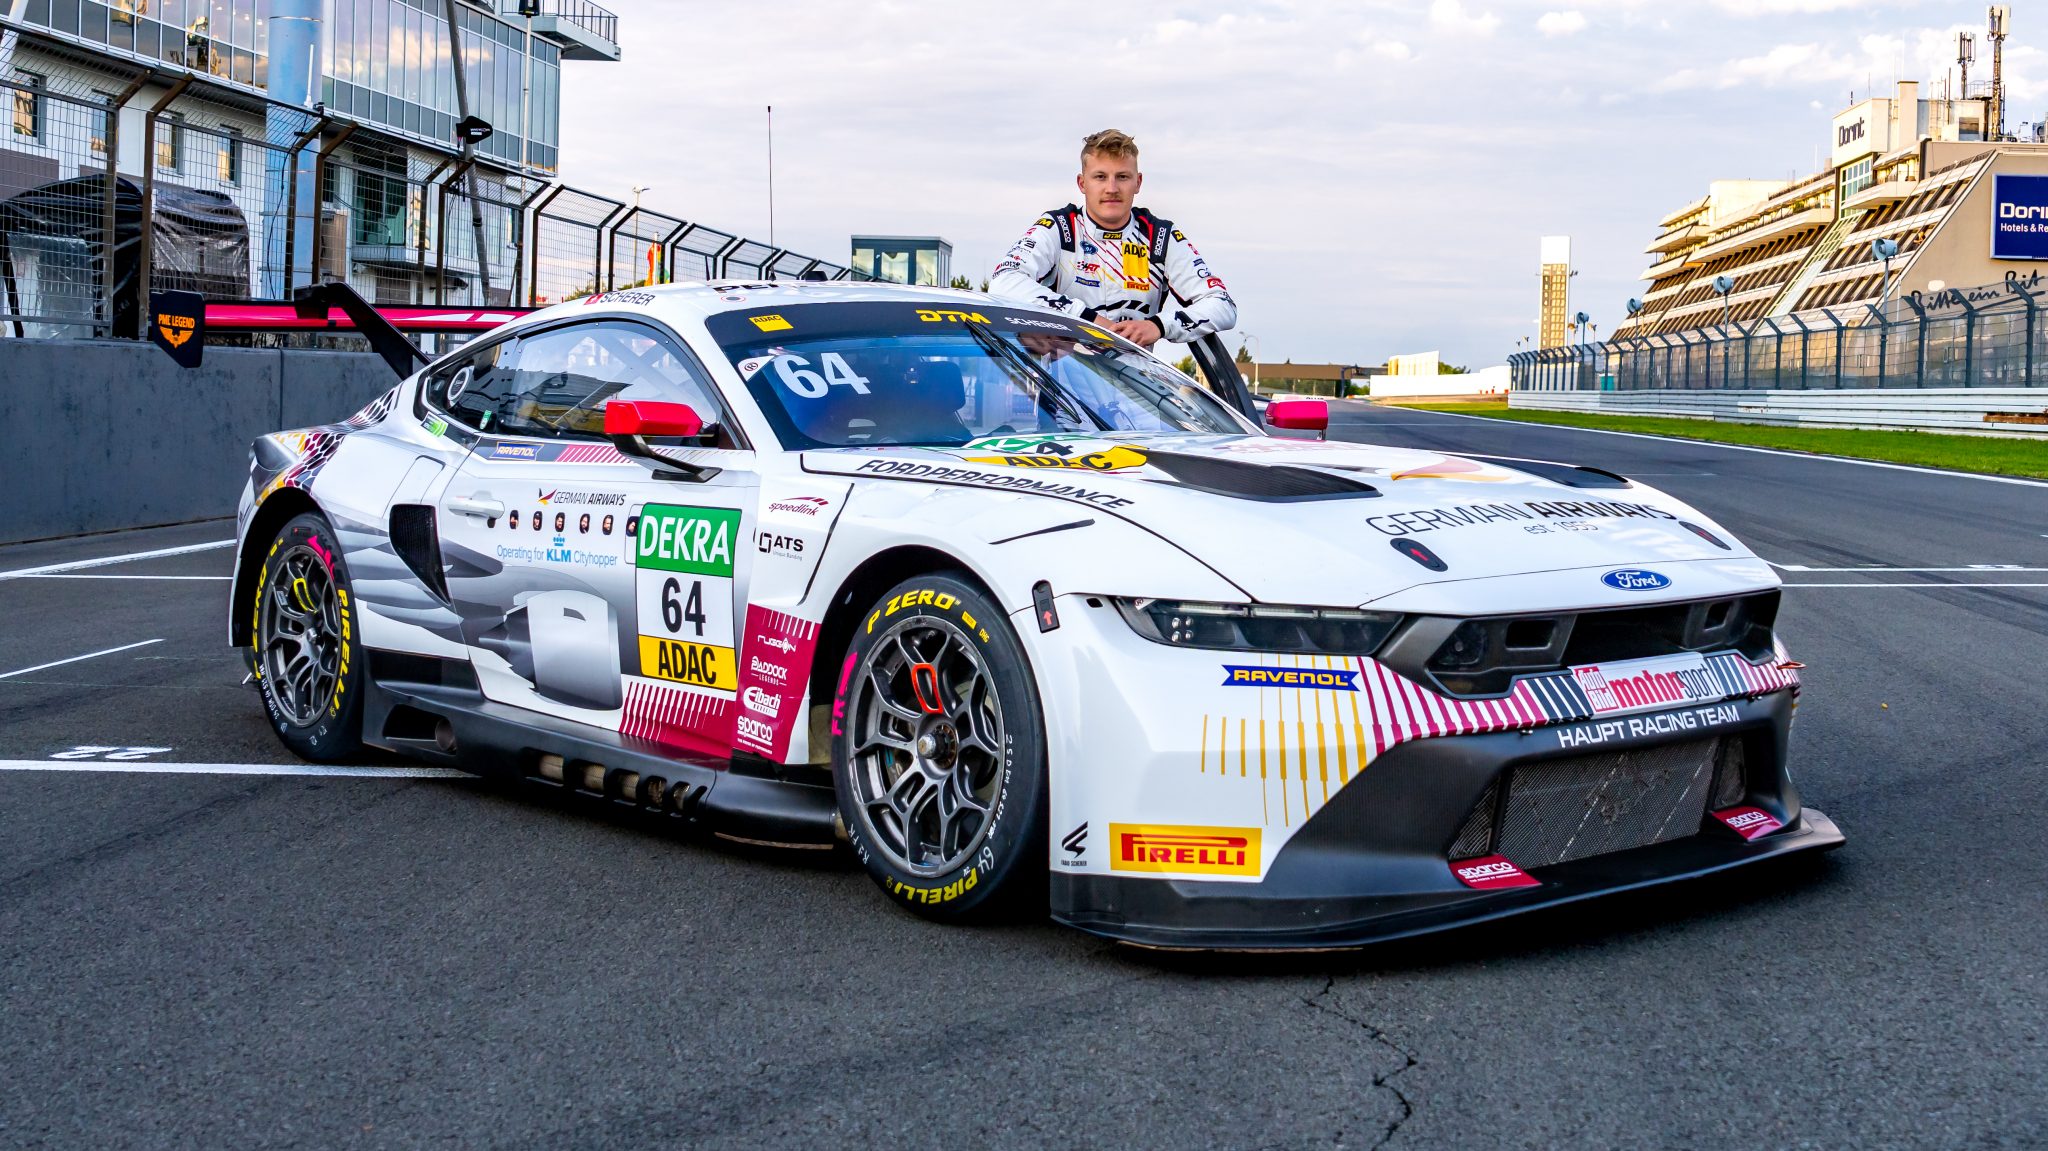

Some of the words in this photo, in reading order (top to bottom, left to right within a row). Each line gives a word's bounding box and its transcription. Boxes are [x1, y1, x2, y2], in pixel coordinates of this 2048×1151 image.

[1839, 116, 1865, 148] Dorint
[2000, 203, 2048, 219] Dori
[1057, 215, 1072, 244] sparco
[2000, 223, 2029, 233] Hotels
[2030, 224, 2037, 233] &
[1154, 227, 1167, 257] sparco
[600, 292, 656, 307] SCHERER
[1968, 287, 2000, 302] ein
[171, 315, 196, 329] LEGEND
[753, 314, 782, 323] ADAC
[916, 309, 992, 325] DTM
[1004, 316, 1073, 332] SCHERER
[773, 352, 872, 399] 64
[496, 445, 536, 457] RAVENOL
[553, 491, 590, 505] GERMAN
[587, 493, 627, 506] AIRWAYS
[768, 502, 818, 516] speedlink
[1366, 503, 1533, 536] GERMAN
[1524, 501, 1678, 520] AIRWAYS
[1524, 523, 1551, 535] est
[1551, 520, 1600, 532] 1955
[639, 515, 731, 565] DEKRA
[773, 535, 804, 552] ATS
[496, 544, 533, 563] Operating
[533, 547, 545, 560] for
[546, 548, 572, 563] KLM
[573, 550, 619, 568] Cityhopper
[1617, 572, 1661, 588] Ford
[661, 577, 707, 637] 64
[867, 609, 881, 635] P
[884, 589, 956, 617] ZERO
[333, 589, 351, 710] PIRELLI
[658, 640, 717, 685] ADAC
[751, 656, 788, 681] PADDOCK
[758, 674, 779, 686] LEGENDS
[1233, 669, 1349, 687] RAVENOL
[743, 686, 782, 714] Eibach
[737, 716, 773, 742] sparco
[832, 698, 846, 737] FR
[1557, 721, 1626, 749] HAUPT
[1628, 711, 1697, 738] RACING
[1699, 704, 1741, 727] TEAM
[978, 846, 995, 875] 64
[1121, 832, 1249, 866] PIRELLI
[1457, 862, 1514, 878] sparco
[893, 867, 978, 905] PIRELLI
